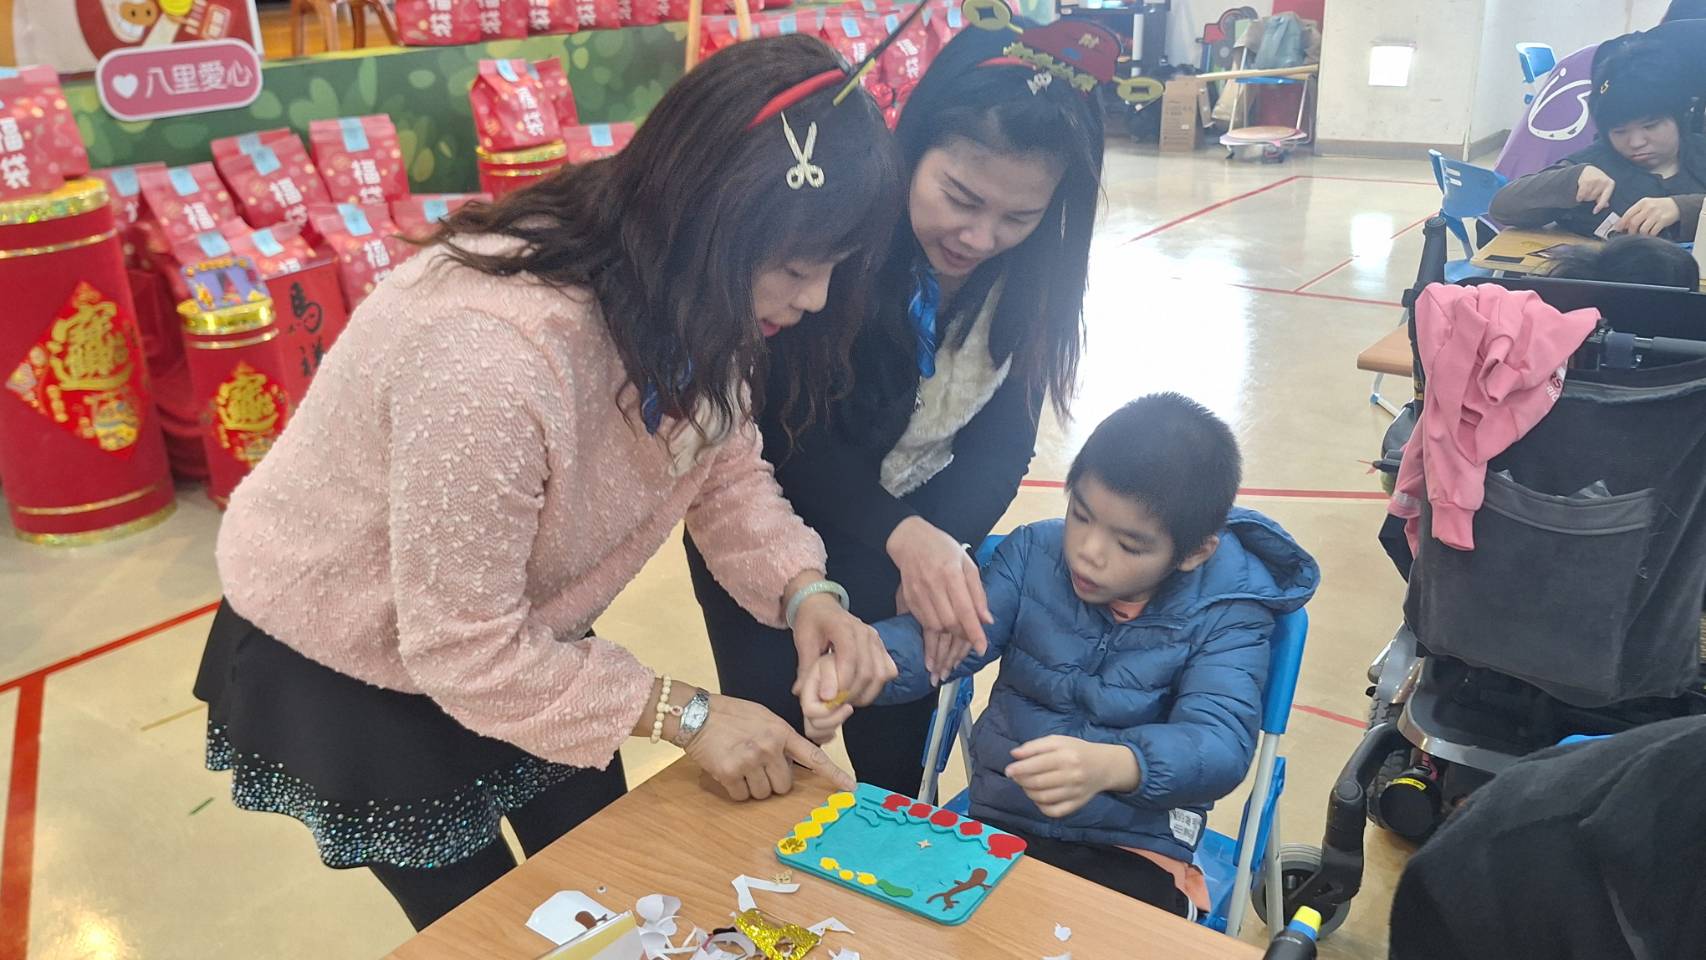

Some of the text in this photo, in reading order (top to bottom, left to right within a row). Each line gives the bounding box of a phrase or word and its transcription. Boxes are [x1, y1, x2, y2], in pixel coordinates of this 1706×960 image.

[145, 60, 253, 98] 八里愛心
[516, 86, 545, 137] 福袋
